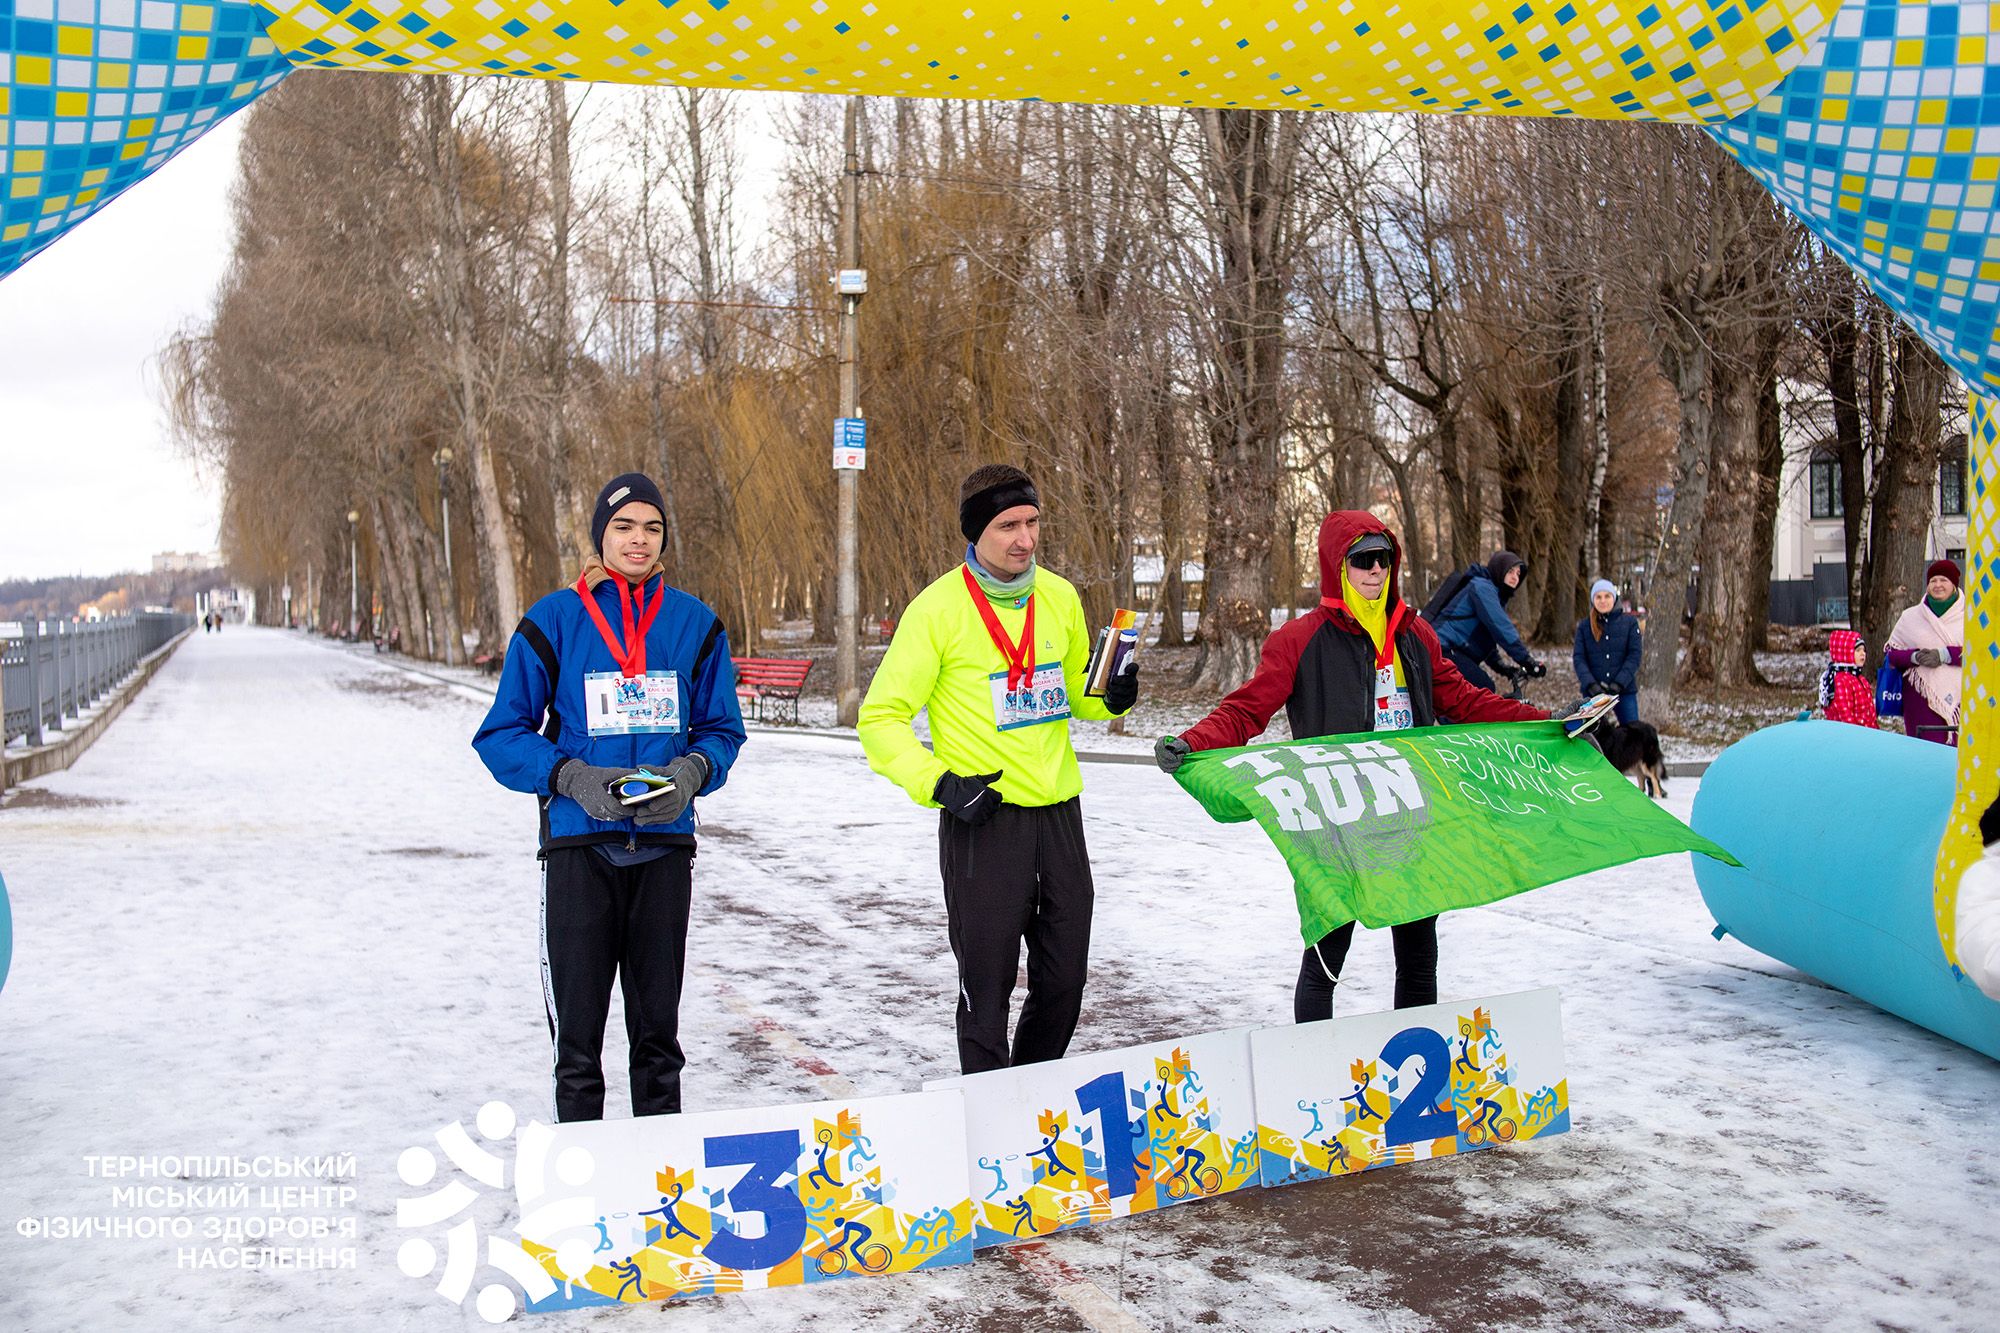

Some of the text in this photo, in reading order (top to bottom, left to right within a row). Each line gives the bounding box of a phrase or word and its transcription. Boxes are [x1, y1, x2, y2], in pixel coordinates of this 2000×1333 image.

[1254, 758, 1424, 831] RUN
[1427, 733, 1592, 780] ERNOPIL
[1434, 748, 1603, 805] RUNNING
[1075, 1071, 1137, 1198] 1
[1378, 1027, 1459, 1147] 2
[704, 1130, 807, 1270] 3
